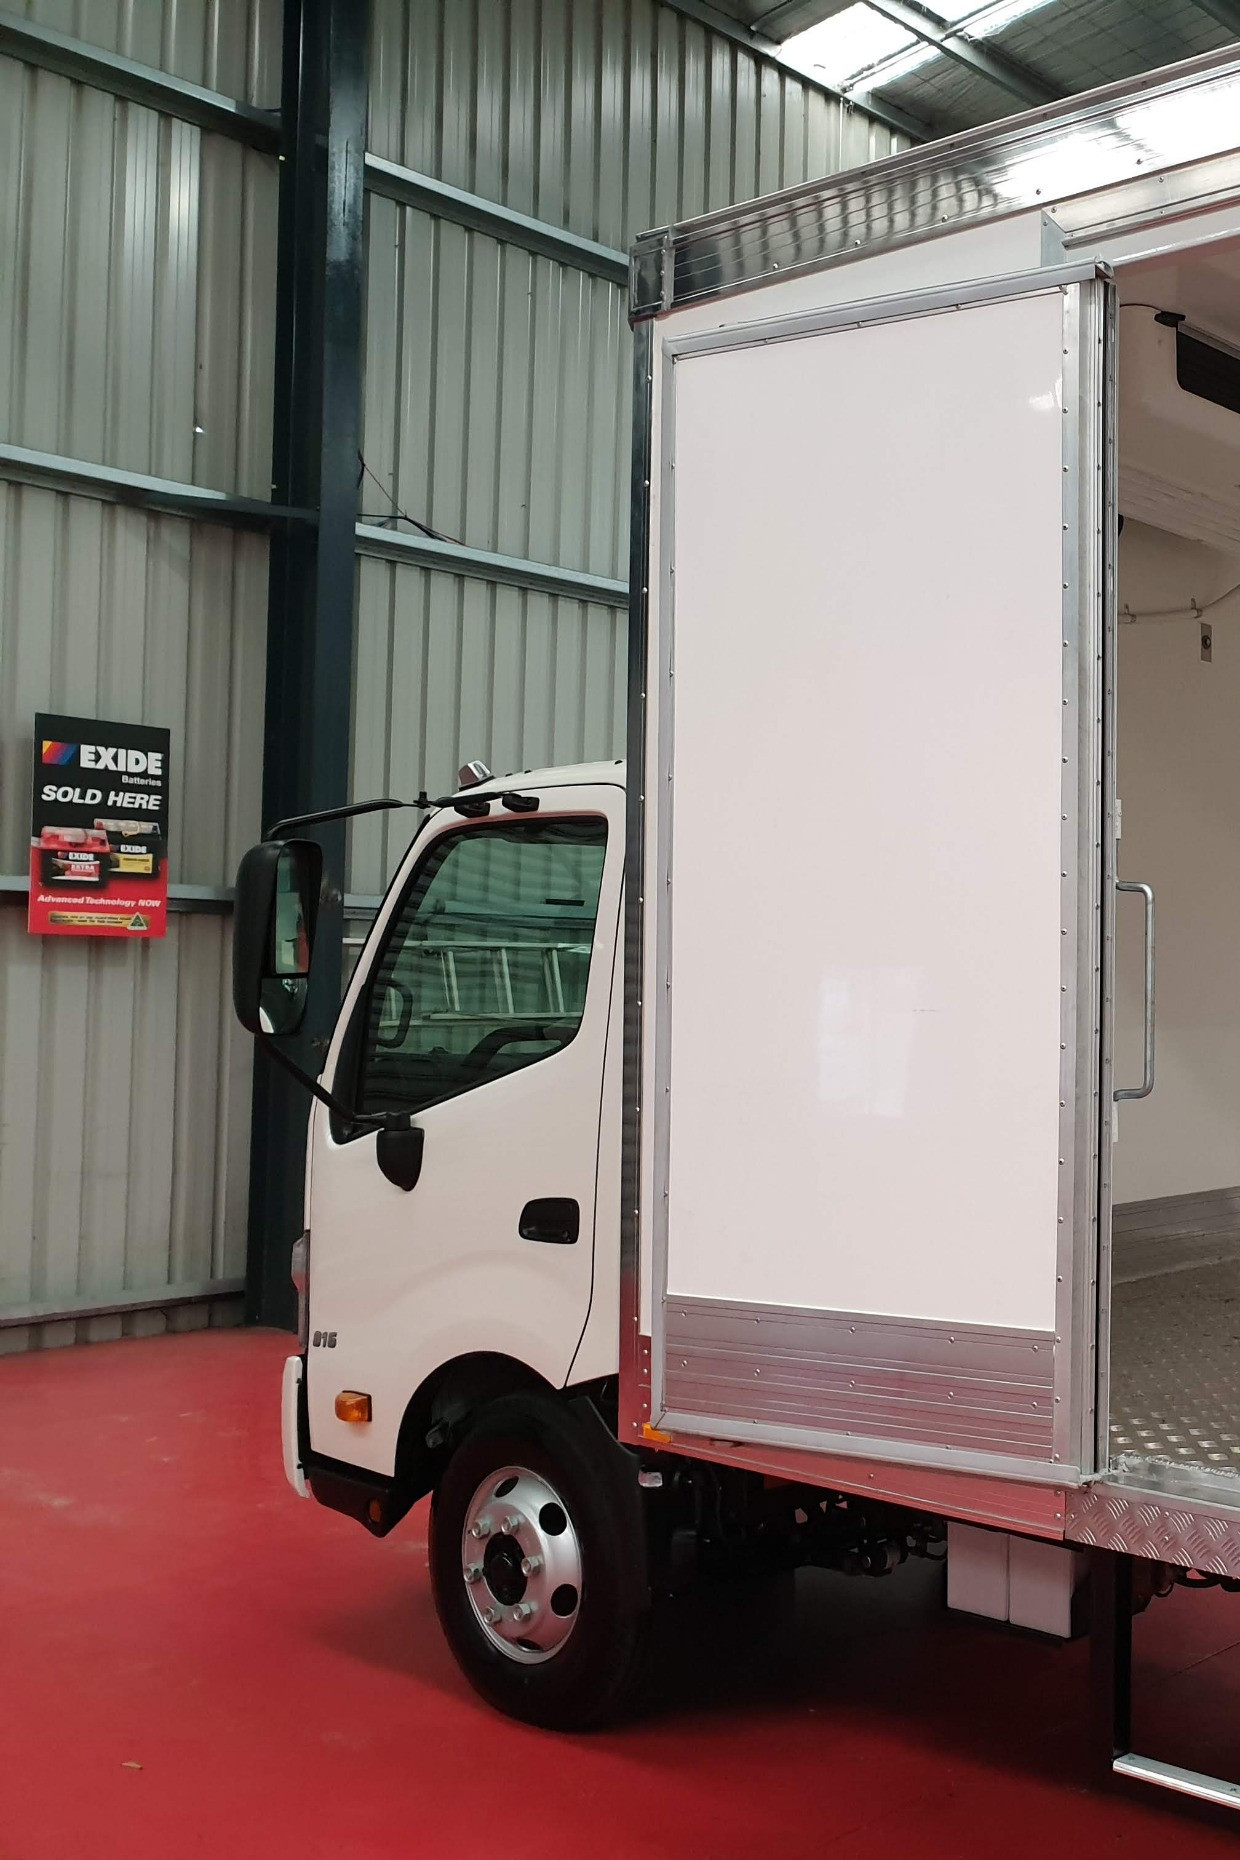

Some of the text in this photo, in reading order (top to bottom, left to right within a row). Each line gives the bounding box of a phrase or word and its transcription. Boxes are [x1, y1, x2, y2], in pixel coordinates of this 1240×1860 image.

[80, 744, 163, 775] EXIDE
[121, 774, 162, 787] Batteries
[41, 784, 162, 810] SOLD HERE
[37, 894, 161, 908] Advanced Technology NOW
